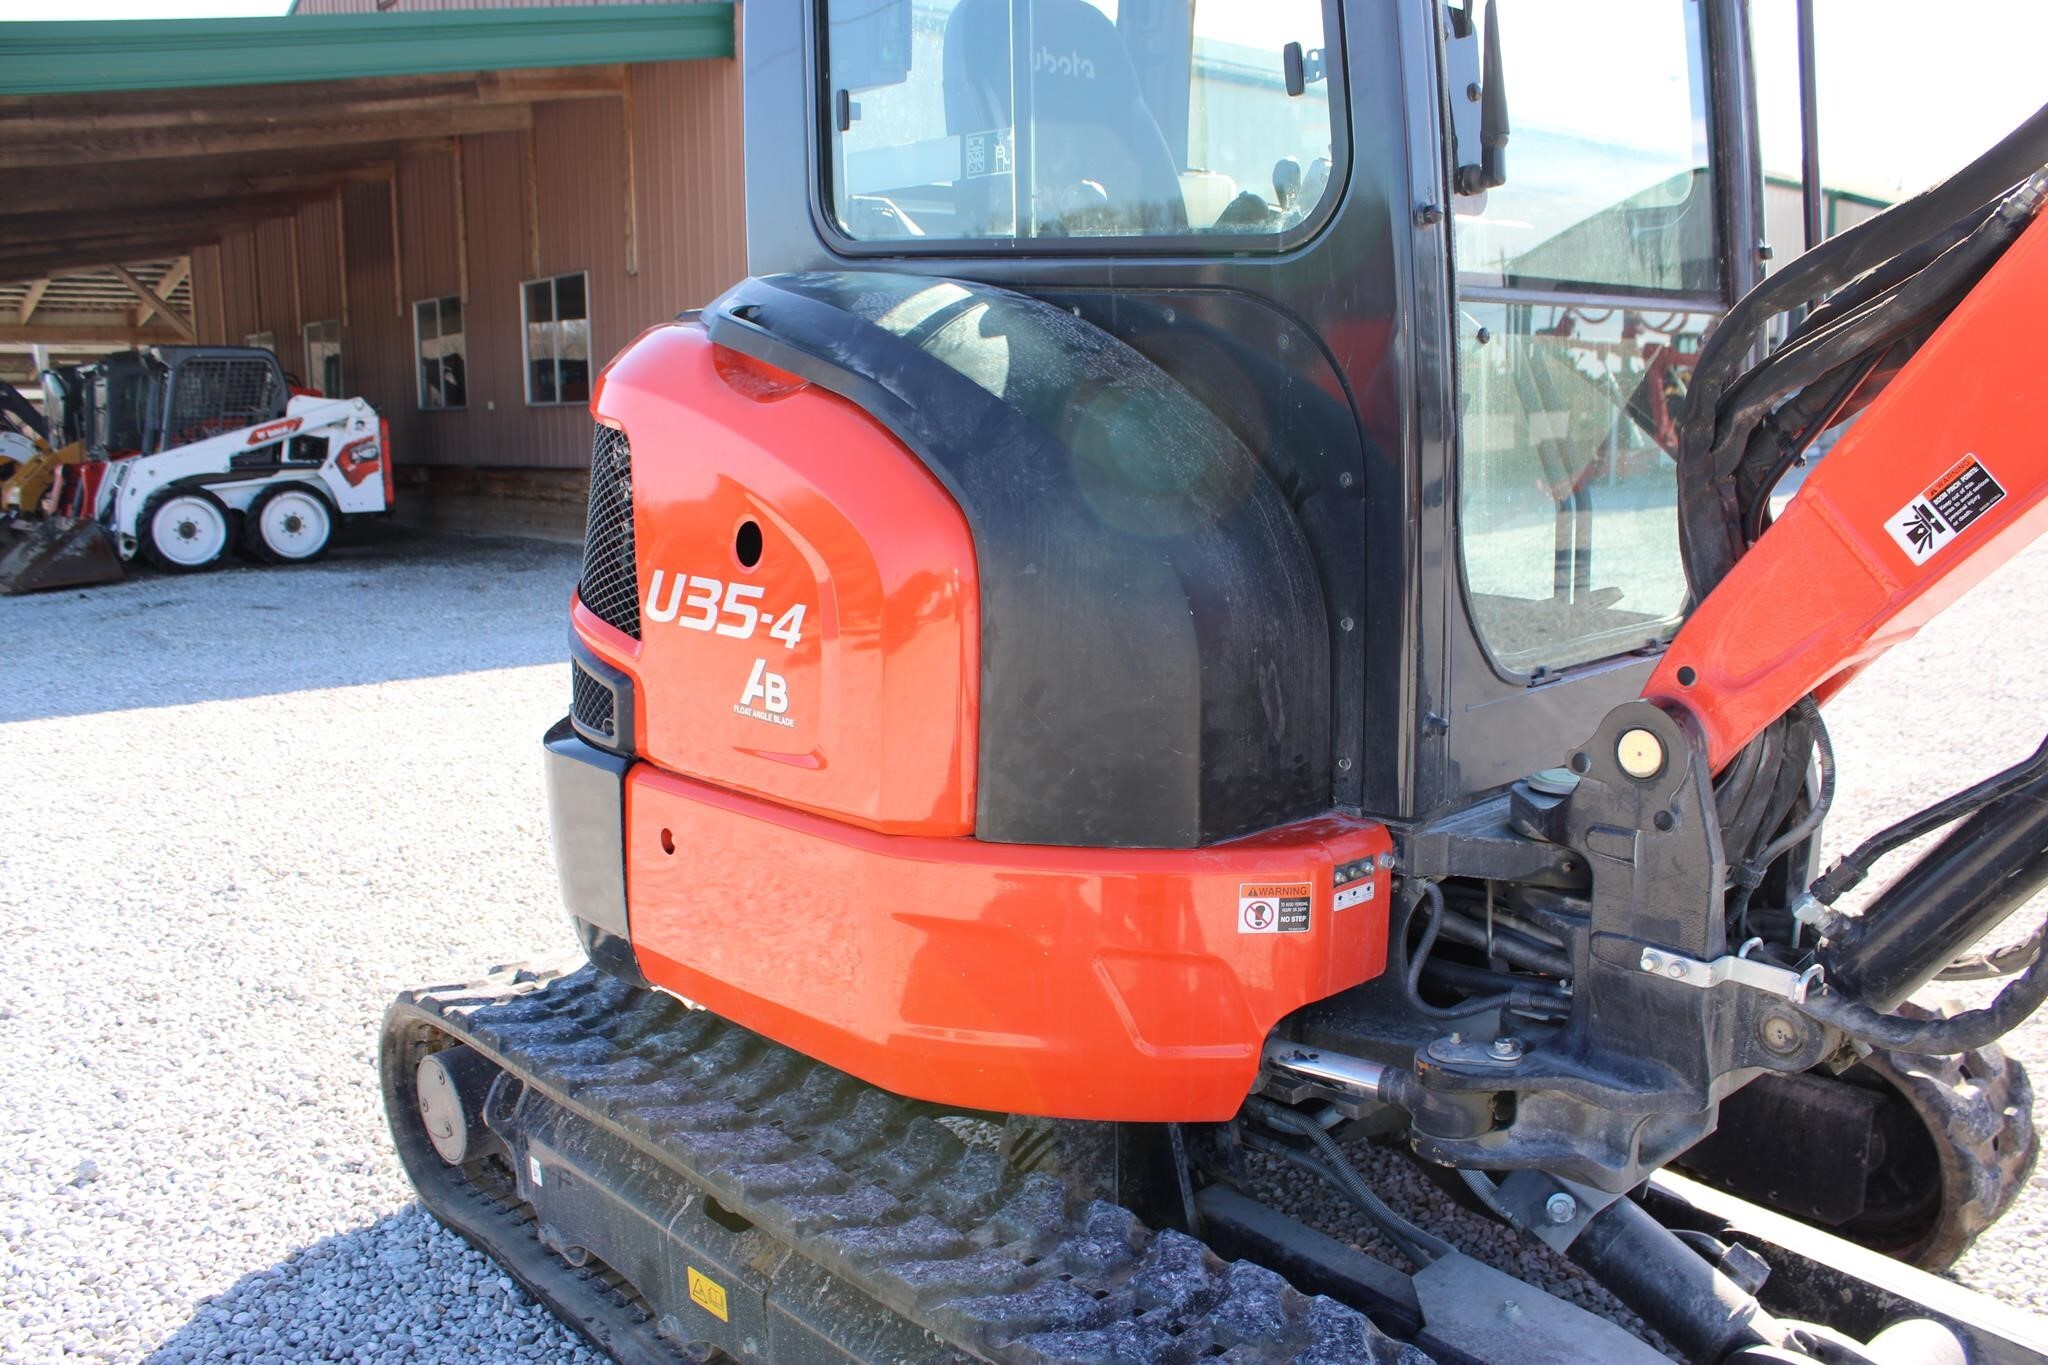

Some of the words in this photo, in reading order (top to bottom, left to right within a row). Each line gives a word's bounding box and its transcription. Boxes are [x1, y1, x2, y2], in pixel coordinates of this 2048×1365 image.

[1032, 45, 1095, 79] ubota
[1936, 460, 1970, 488] WARNING
[1939, 500, 1952, 511] Keep
[1952, 493, 1960, 501] out
[1944, 506, 1955, 516] area
[1960, 491, 1973, 503] avoid
[1972, 478, 1990, 493] serious
[1948, 504, 1968, 522] personal
[1967, 494, 1980, 506] injury
[645, 569, 807, 649] U35-4
[740, 658, 788, 714] AB
[733, 704, 752, 716] FLOAT
[752, 709, 773, 722] ANGLE
[773, 714, 795, 728] BLADE
[1259, 887, 1307, 896] WARNING
[1291, 915, 1307, 923] STEP
